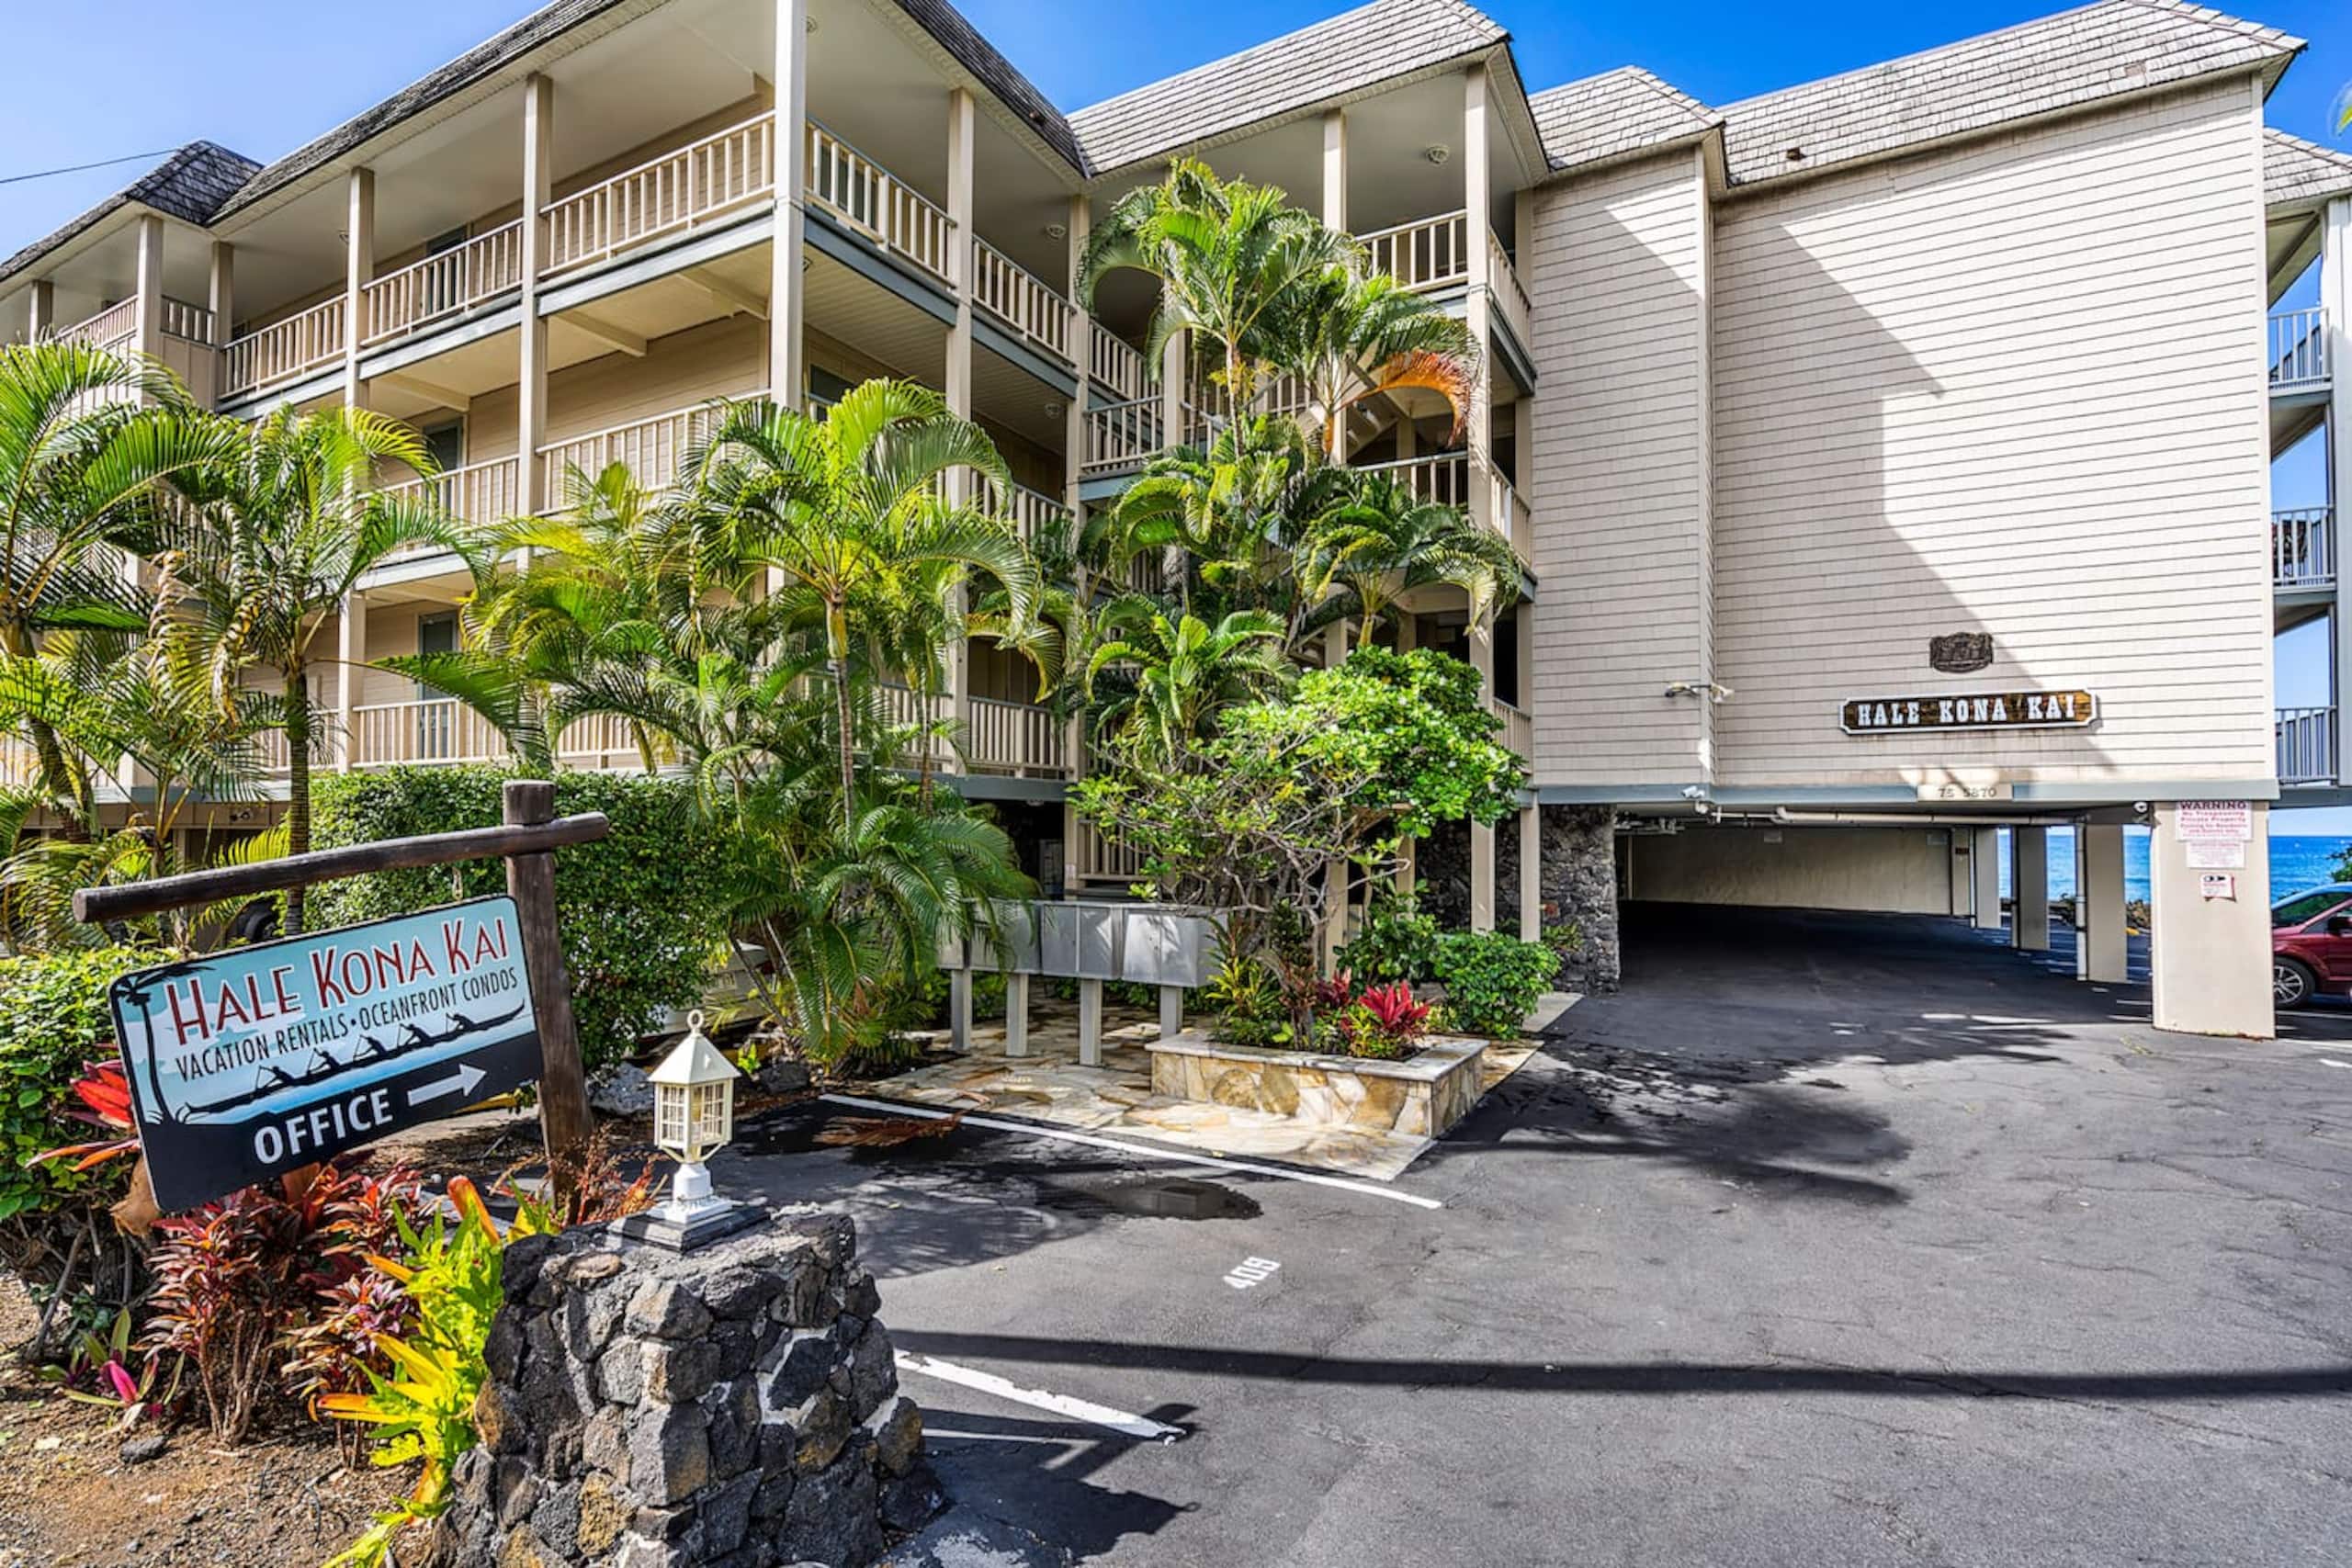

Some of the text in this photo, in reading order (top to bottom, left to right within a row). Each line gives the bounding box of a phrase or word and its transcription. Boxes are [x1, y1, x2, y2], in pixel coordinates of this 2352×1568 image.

[1857, 694, 2075, 727] HALE KONA KAI
[1939, 787, 1955, 798] 75
[2179, 800, 2247, 809] WARNING
[165, 919, 509, 1046] HALE KONA KAI
[175, 1037, 269, 1083] VACATION
[461, 966, 518, 1002] CONDOS
[254, 1088, 394, 1165] OFFICE
[1223, 1256, 1282, 1289] 409
